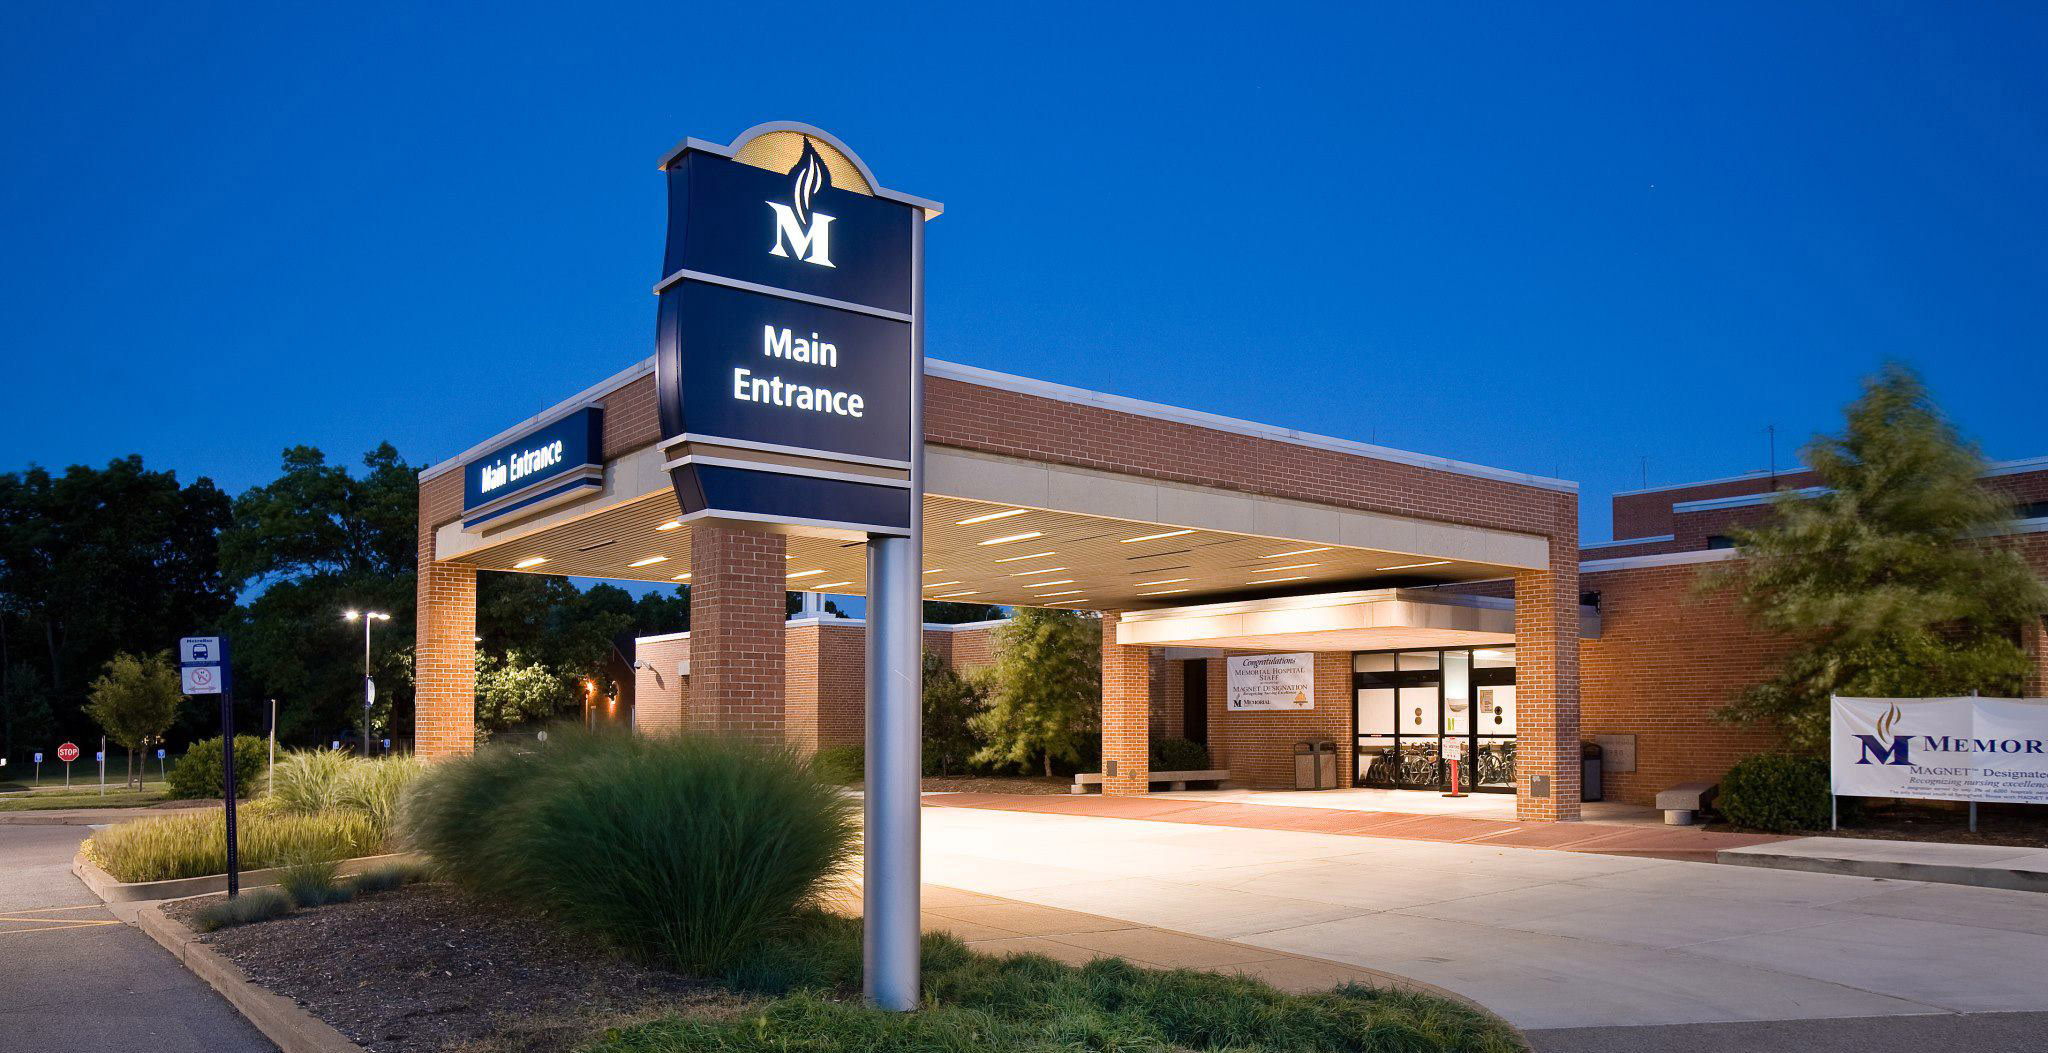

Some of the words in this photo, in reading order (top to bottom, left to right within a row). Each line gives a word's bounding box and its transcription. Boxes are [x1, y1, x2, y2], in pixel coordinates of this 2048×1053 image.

[766, 200, 837, 268] M
[763, 324, 838, 368] Main
[733, 367, 865, 418] Entrance
[481, 459, 507, 494] Main
[510, 439, 563, 482] Entrance
[1234, 668, 1270, 676] MEMORIAL
[1272, 667, 1305, 675] HOSPITAL
[59, 748, 78, 757] STOP
[1852, 734, 1917, 766] M
[1922, 735, 2048, 754] MEMOR
[1909, 776, 1962, 787] Recognizing
[1963, 779, 2000, 788] nursing
